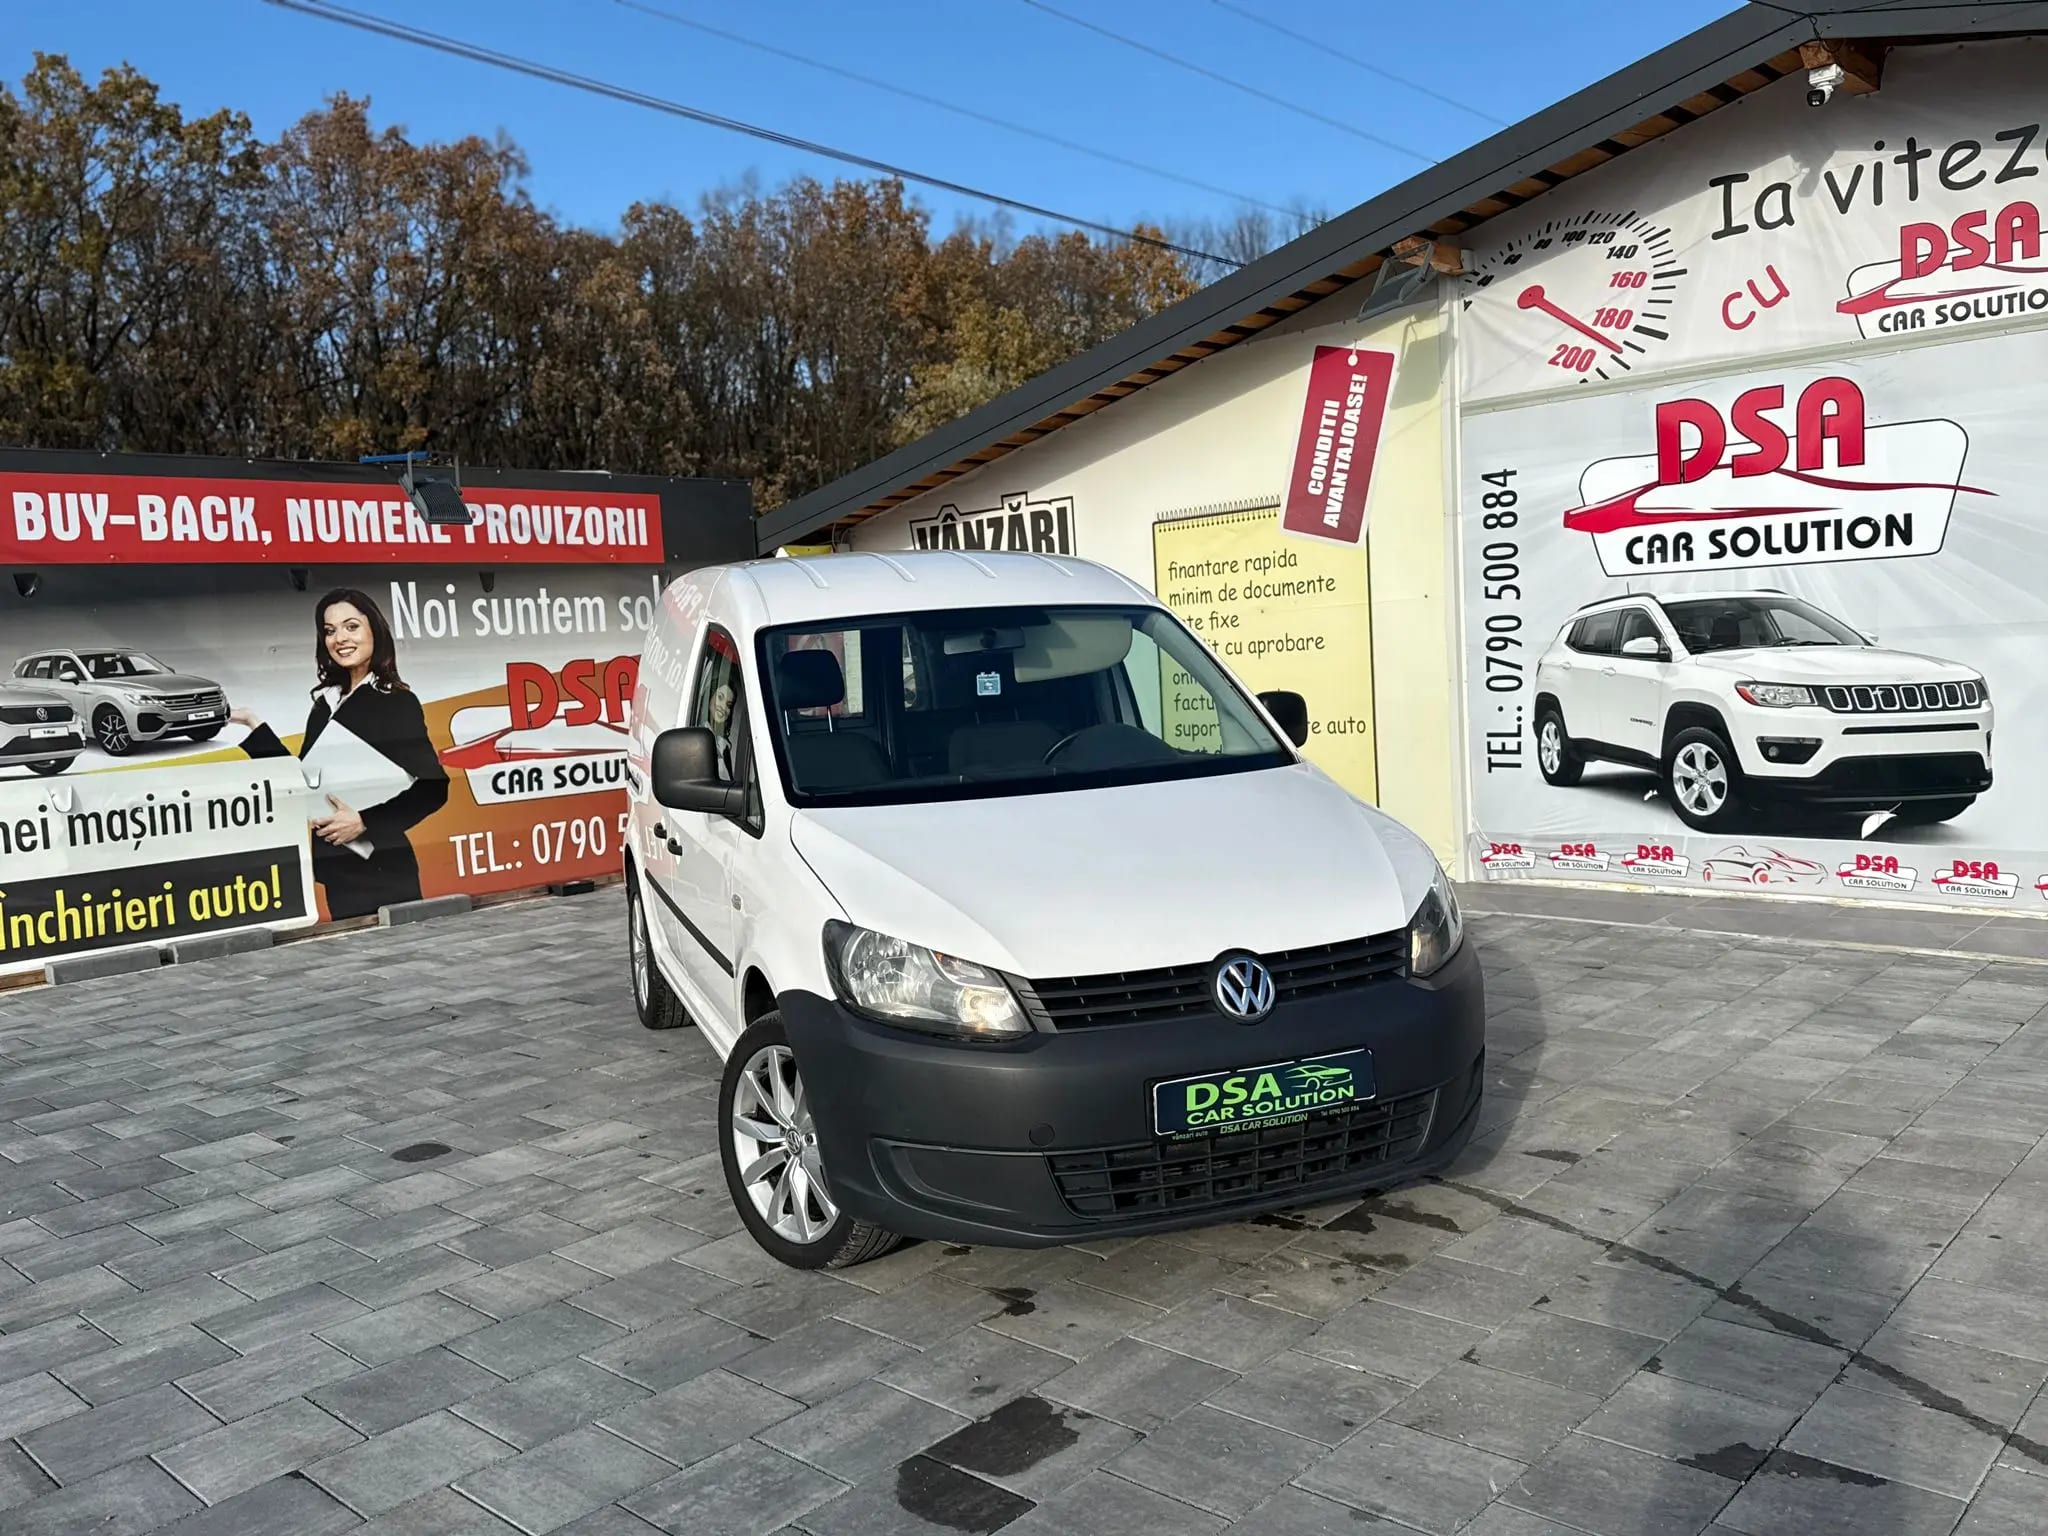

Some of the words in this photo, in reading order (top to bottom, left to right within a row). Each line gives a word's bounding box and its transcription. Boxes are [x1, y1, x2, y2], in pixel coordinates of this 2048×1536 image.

[1708, 172, 1795, 241] Ia
[1823, 123, 2048, 215] vitez
[1588, 231, 1616, 245] 120
[1606, 244, 1639, 260] 140
[1900, 201, 2041, 280] DSA
[1609, 271, 1648, 289] 160
[1722, 264, 1790, 331] cu
[1591, 307, 1633, 330] 180
[1878, 309, 1926, 333] CAR
[1547, 343, 1597, 373] 200
[1307, 399, 1341, 496] CONDITII
[1656, 376, 1865, 487] DSA
[1322, 373, 1368, 529] AVANTAJOASE!
[1481, 468, 1519, 530] 884
[12, 491, 273, 546] BUY-BACK,
[463, 503, 649, 546] PROVIZORII
[1626, 531, 1694, 565] CAR
[1708, 512, 1913, 560] SOLUTION
[1168, 559, 1240, 582] finantare
[1244, 548, 1298, 576] rapida
[1482, 541, 1521, 601] 500
[1168, 586, 1213, 607] minim
[1217, 582, 1238, 602] de
[1242, 574, 1337, 601] documente
[390, 580, 460, 639] Noi
[471, 587, 607, 637] suntem
[1209, 610, 1241, 632] fixe
[1224, 642, 1243, 656] cu
[1247, 632, 1326, 660] aprobare
[1485, 614, 1523, 693] 0790
[506, 655, 641, 730] DSA
[1174, 722, 1221, 743] supor
[1326, 716, 1367, 735] auto
[1486, 705, 1522, 774] TEL.:
[491, 767, 544, 796] CAR
[67, 789, 193, 851] mașini
[207, 779, 275, 830] noi!
[448, 830, 523, 878] TEL.:
[530, 815, 607, 866] 0790
[1560, 843, 1597, 857] DSA
[1637, 844, 1674, 861] DSA
[1572, 861, 1604, 869] SOLUTION
[1632, 866, 1646, 874] CAR
[1648, 866, 1683, 876] SOLUTION
[1855, 854, 1899, 874] DSA
[1952, 860, 1999, 881] DSA
[188, 863, 283, 922] auto!
[1848, 878, 1864, 886] CAR
[1866, 879, 1908, 890] SOLUTION
[1945, 884, 1962, 893] CAR
[1964, 885, 2009, 896] SOLUTION
[1185, 1072, 1283, 1112] DSA
[1186, 1103, 1235, 1126] CAR
[1242, 1085, 1355, 1117] SOLUTION
[1219, 1124, 1241, 1135] DSA
[1241, 1121, 1261, 1132] CAR
[1262, 1113, 1309, 1128] SOLUTION
